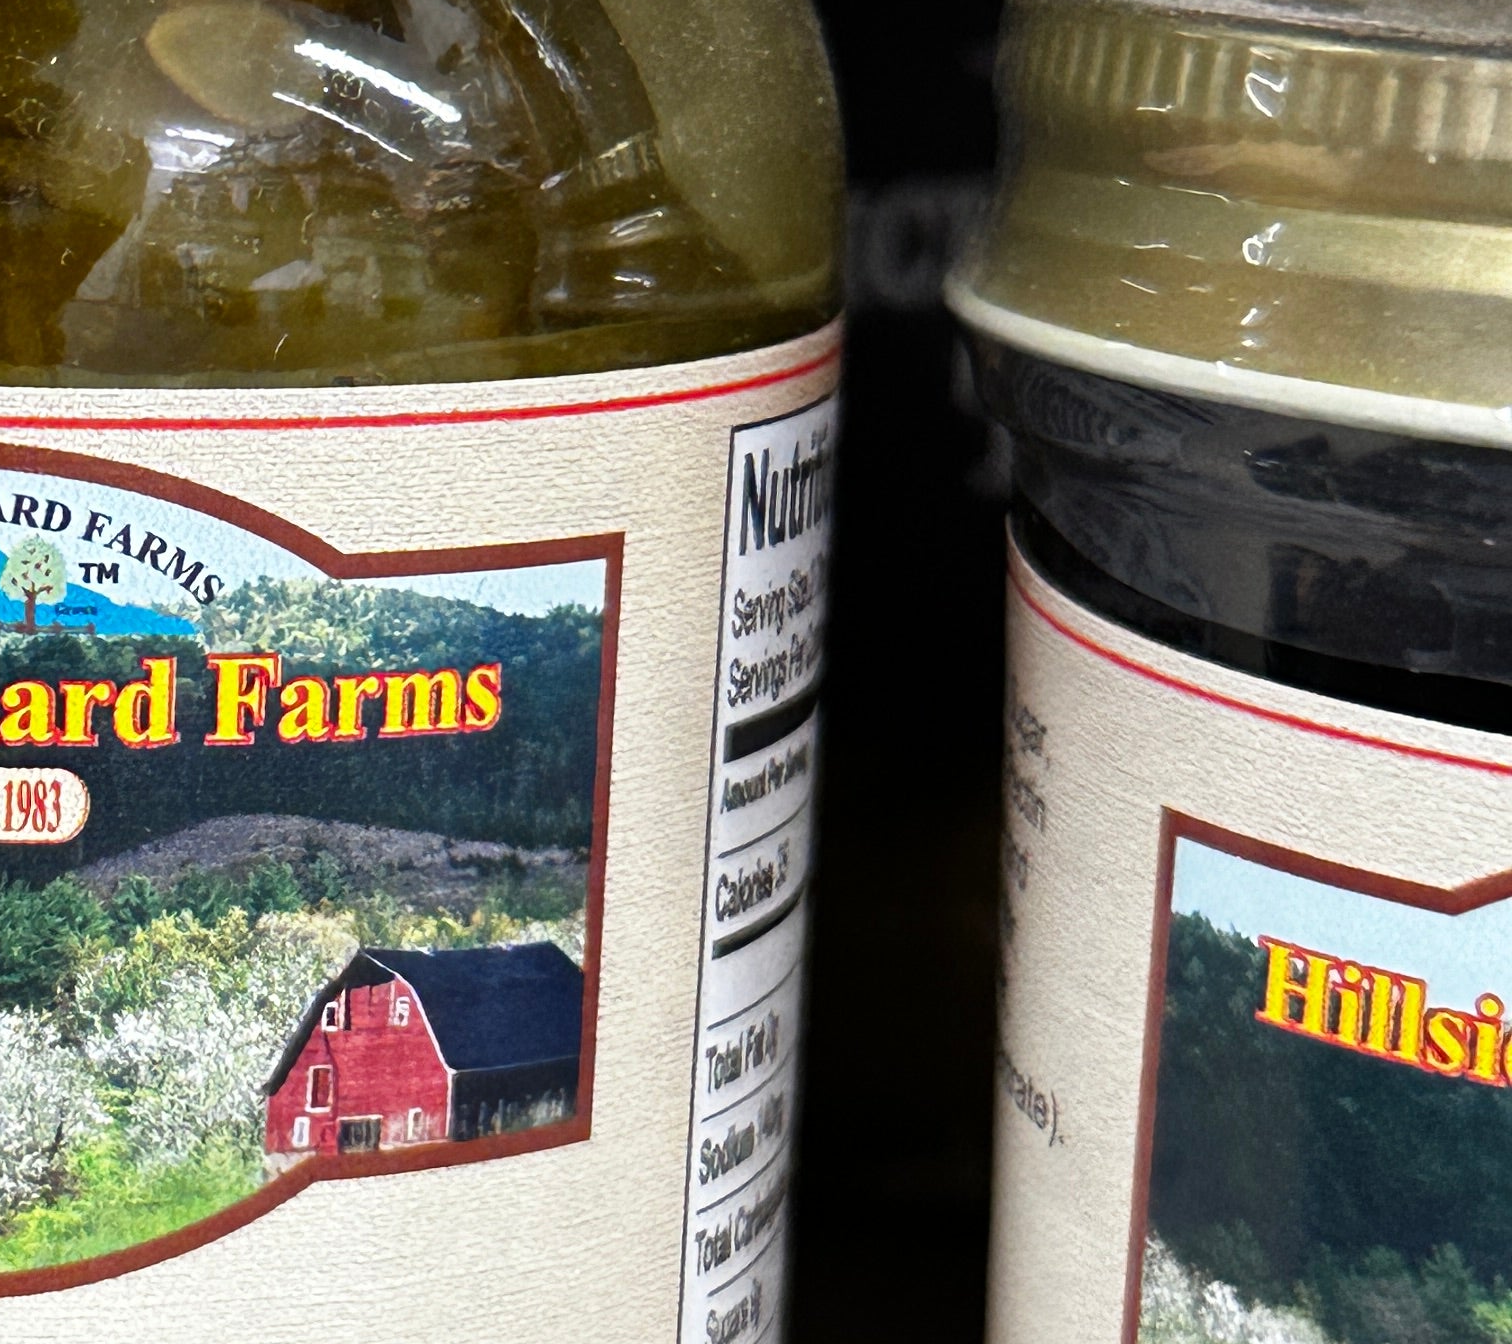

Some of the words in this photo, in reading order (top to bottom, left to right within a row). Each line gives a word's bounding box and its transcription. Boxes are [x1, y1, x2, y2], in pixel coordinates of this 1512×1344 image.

[78, 509, 225, 606] FARMS
[79, 562, 119, 584] TM
[204, 653, 503, 747] Farms
[2, 779, 63, 832] 1983
[1254, 934, 1512, 1089] Hillsi
